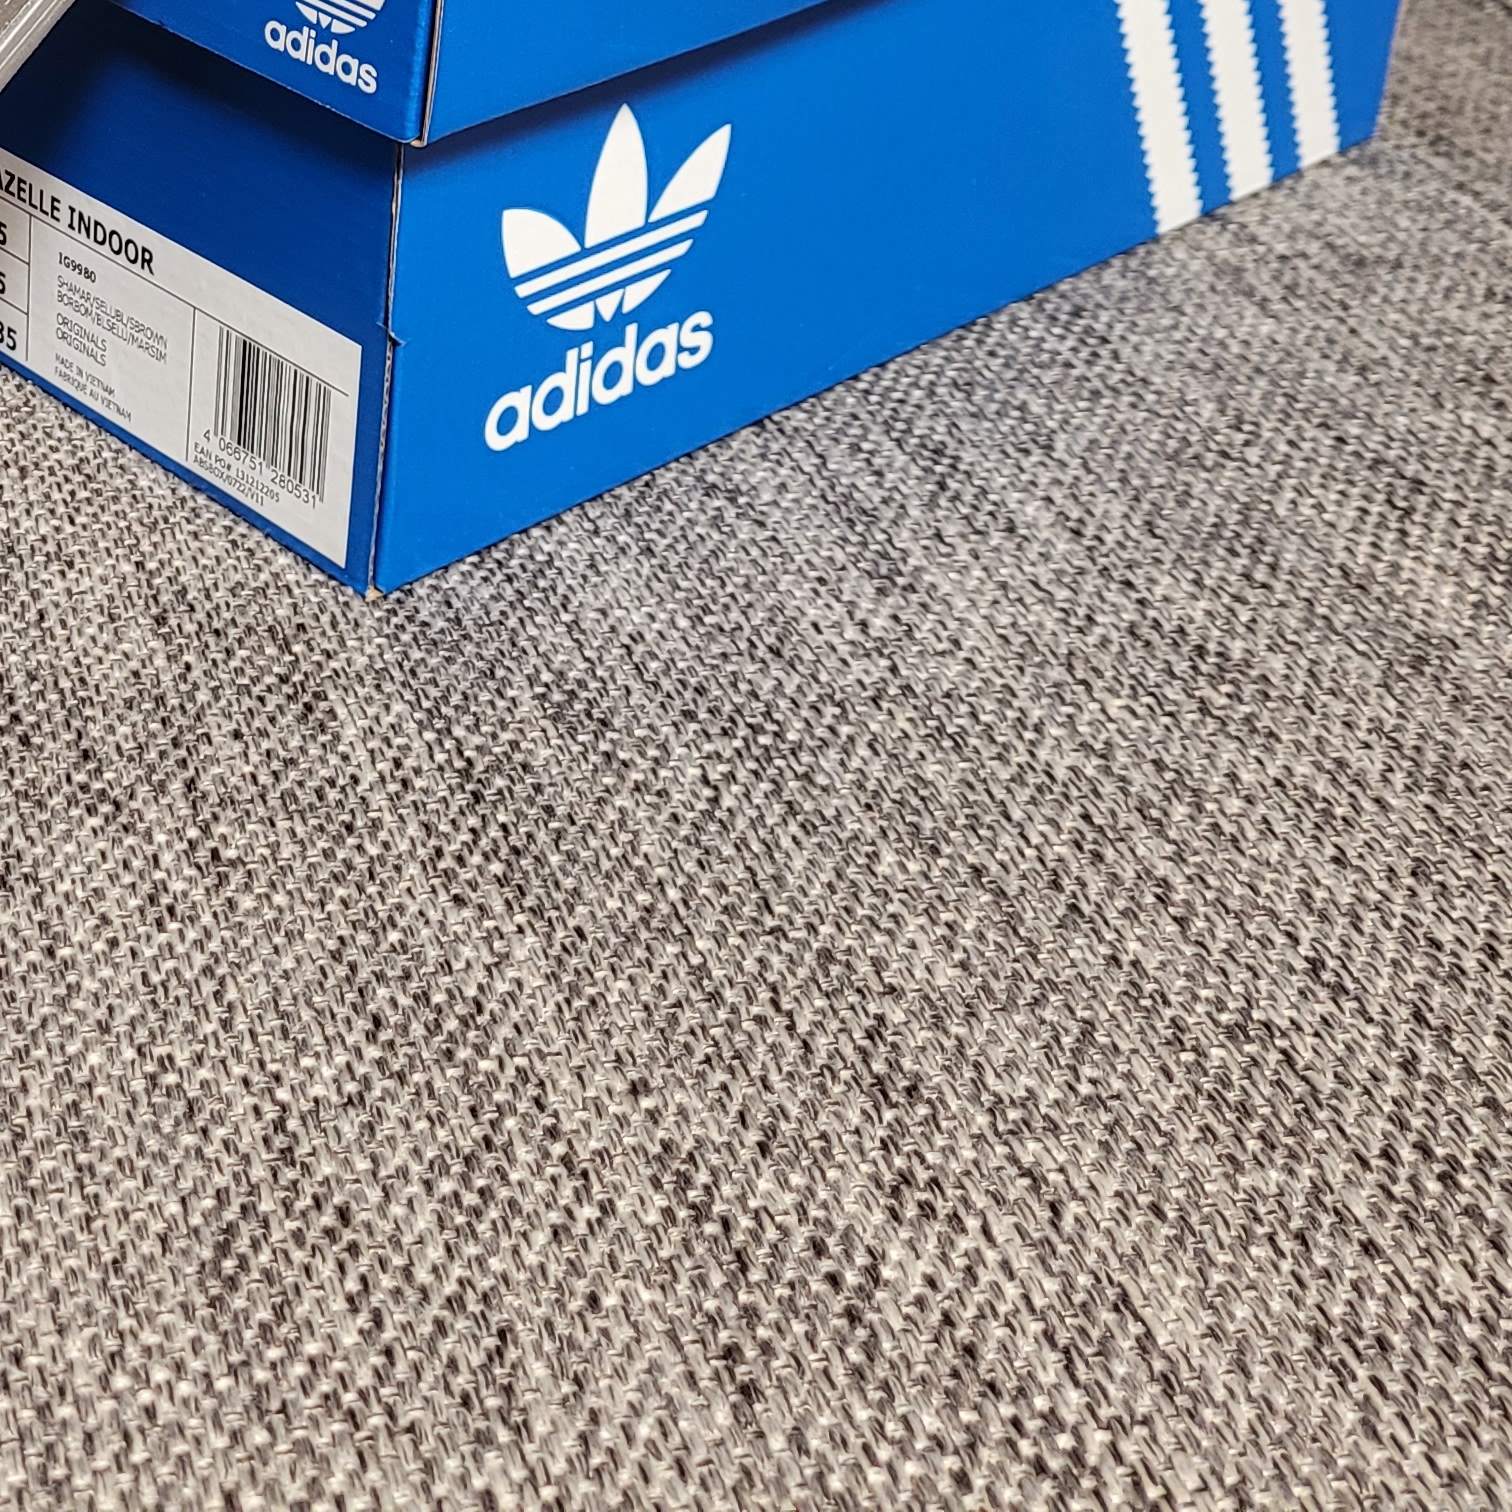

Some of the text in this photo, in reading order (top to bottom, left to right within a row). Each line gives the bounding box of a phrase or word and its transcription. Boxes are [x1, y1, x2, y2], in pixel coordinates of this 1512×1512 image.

[263, 18, 378, 94] adidas
[68, 204, 155, 276] INDOOR
[58, 251, 97, 284] IG9980
[55, 327, 107, 367] ORIGINALS
[56, 312, 107, 352] ORIGINALS
[54, 352, 74, 373] MADE
[85, 371, 116, 398] VIETNAM
[483, 310, 715, 452] adidas
[89, 388, 99, 402] AU
[100, 394, 132, 423] VIETNAM
[194, 441, 212, 461] EAN
[235, 467, 280, 503] 131212205
[203, 429, 316, 509] 4 066751 280531
